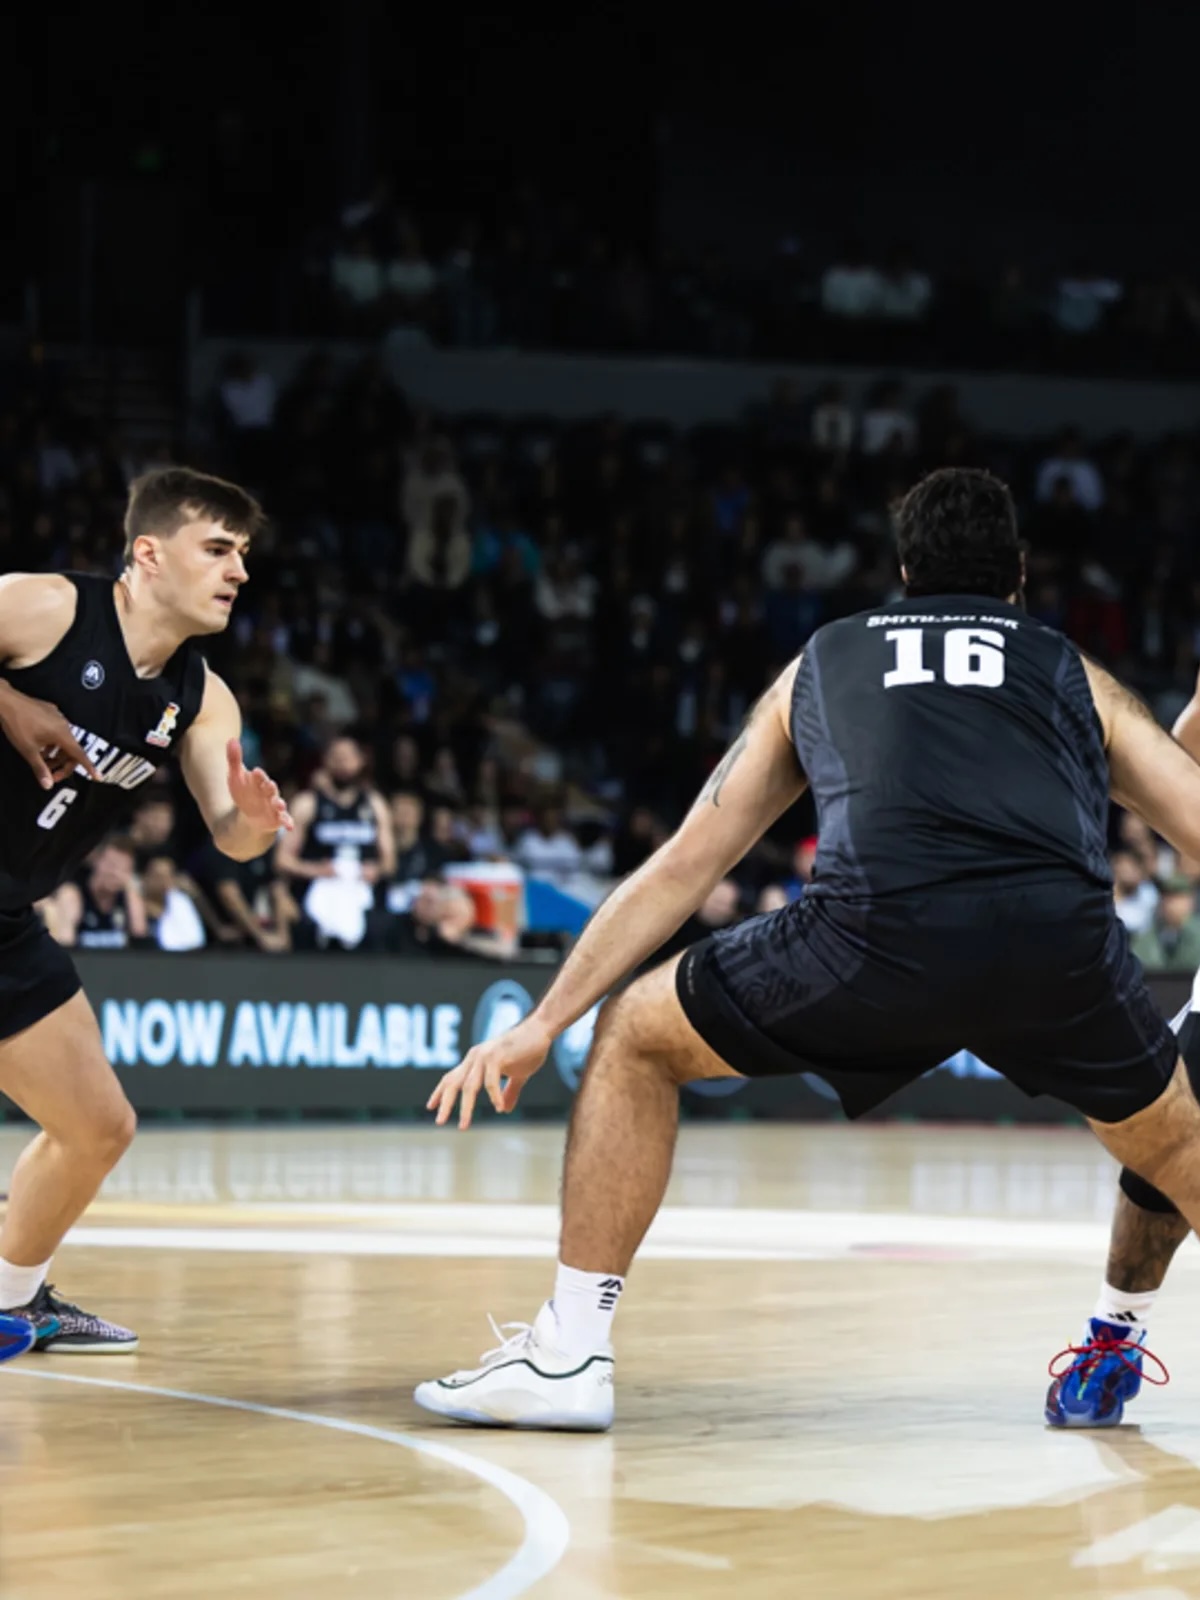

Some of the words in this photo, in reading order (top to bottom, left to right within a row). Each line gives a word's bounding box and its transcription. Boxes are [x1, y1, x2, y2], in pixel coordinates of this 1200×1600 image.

[884, 628, 1005, 688] 16
[37, 788, 78, 829] 6
[102, 999, 226, 1067] NOW
[228, 1000, 463, 1068] AVAILABLE
